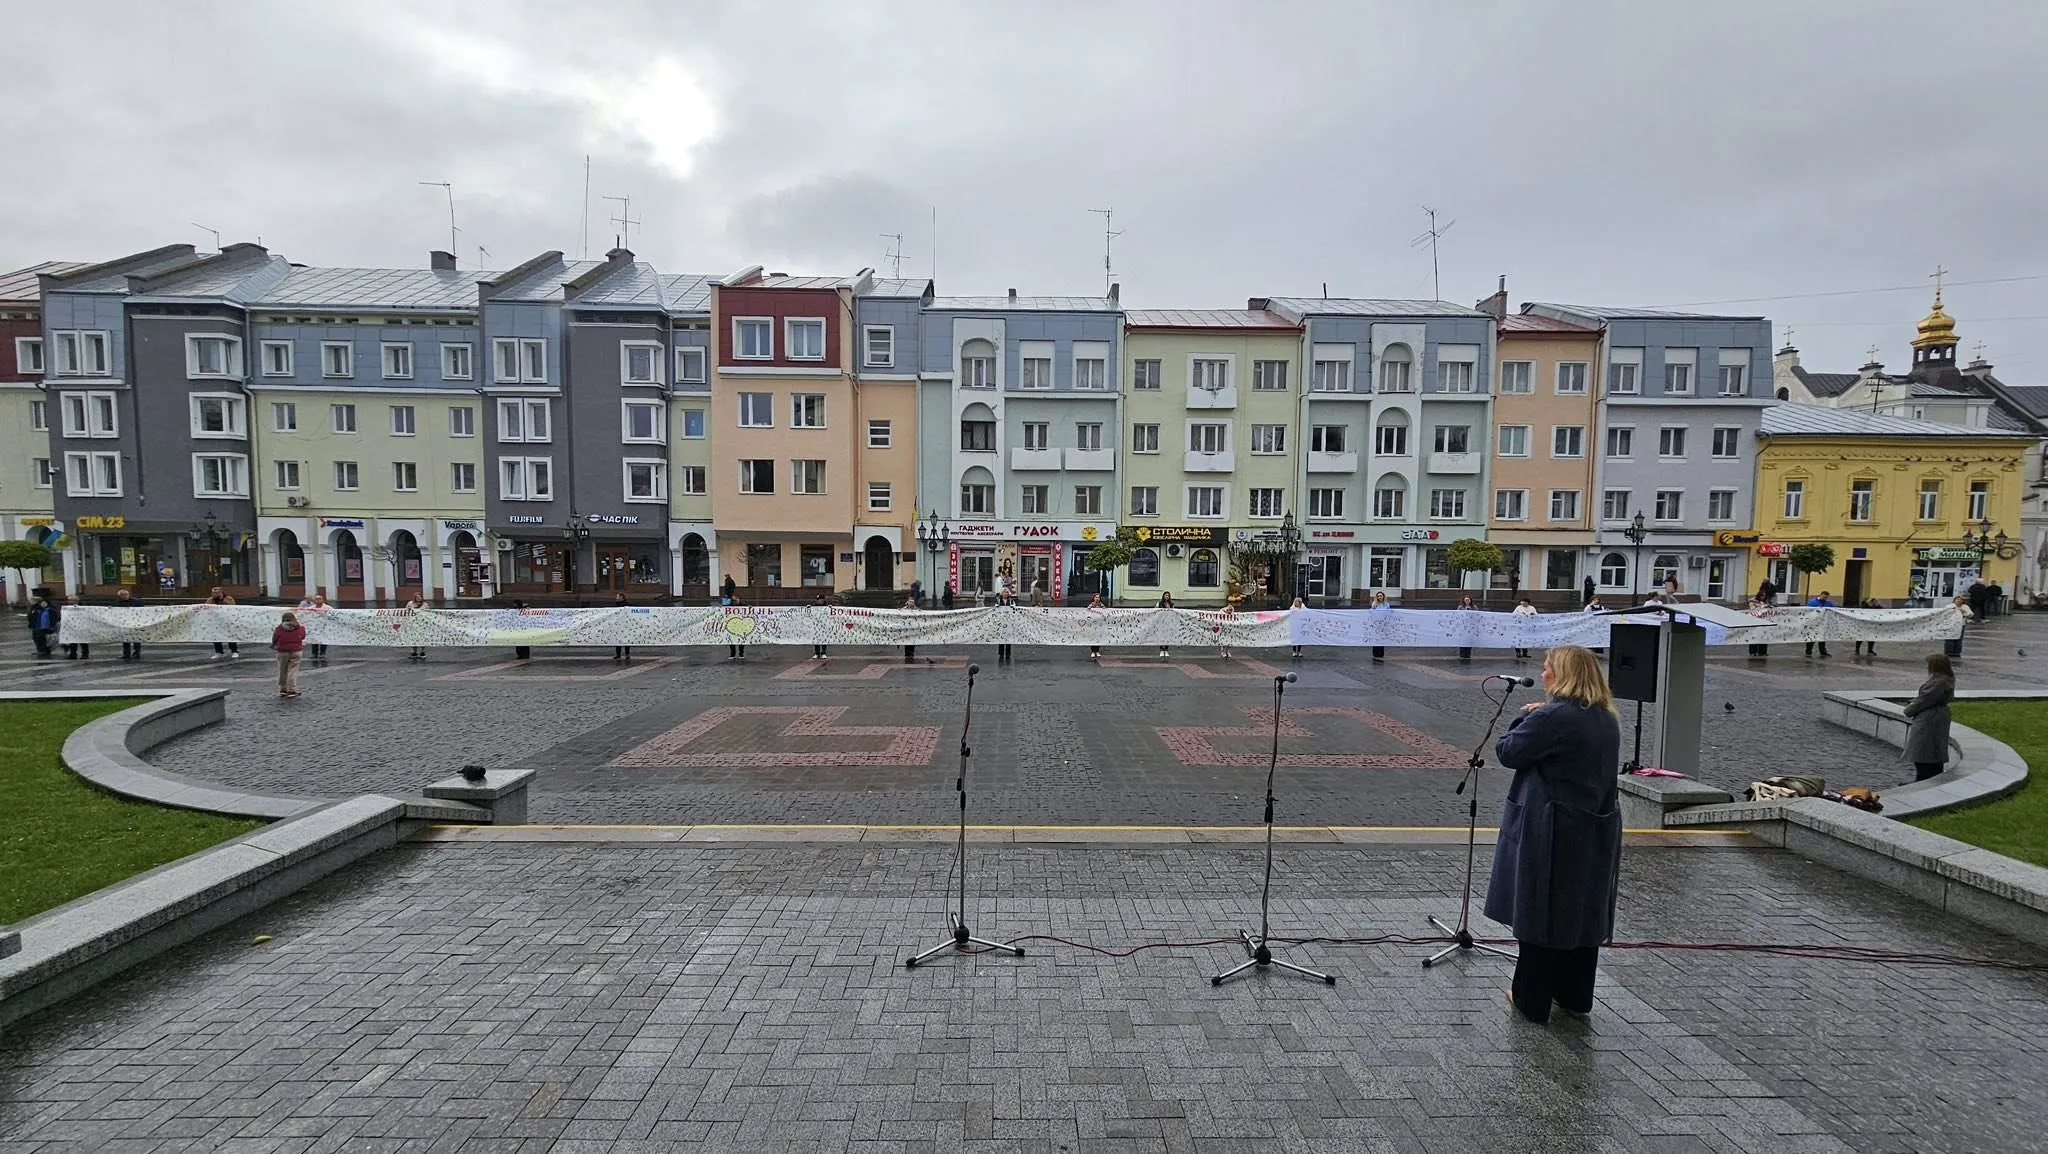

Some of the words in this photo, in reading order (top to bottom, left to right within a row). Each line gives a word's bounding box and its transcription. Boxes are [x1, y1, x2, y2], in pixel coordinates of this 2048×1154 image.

[106, 517, 125, 528] 23
[509, 515, 543, 523] FUJIFILM
[623, 516, 638, 524] ПІК
[1013, 526, 1059, 536] ГУДОК
[1152, 528, 1211, 536] СТОЛИЧНА
[725, 606, 774, 615] ВОЛИНЬ
[830, 607, 875, 617] ВОЛИНЬ
